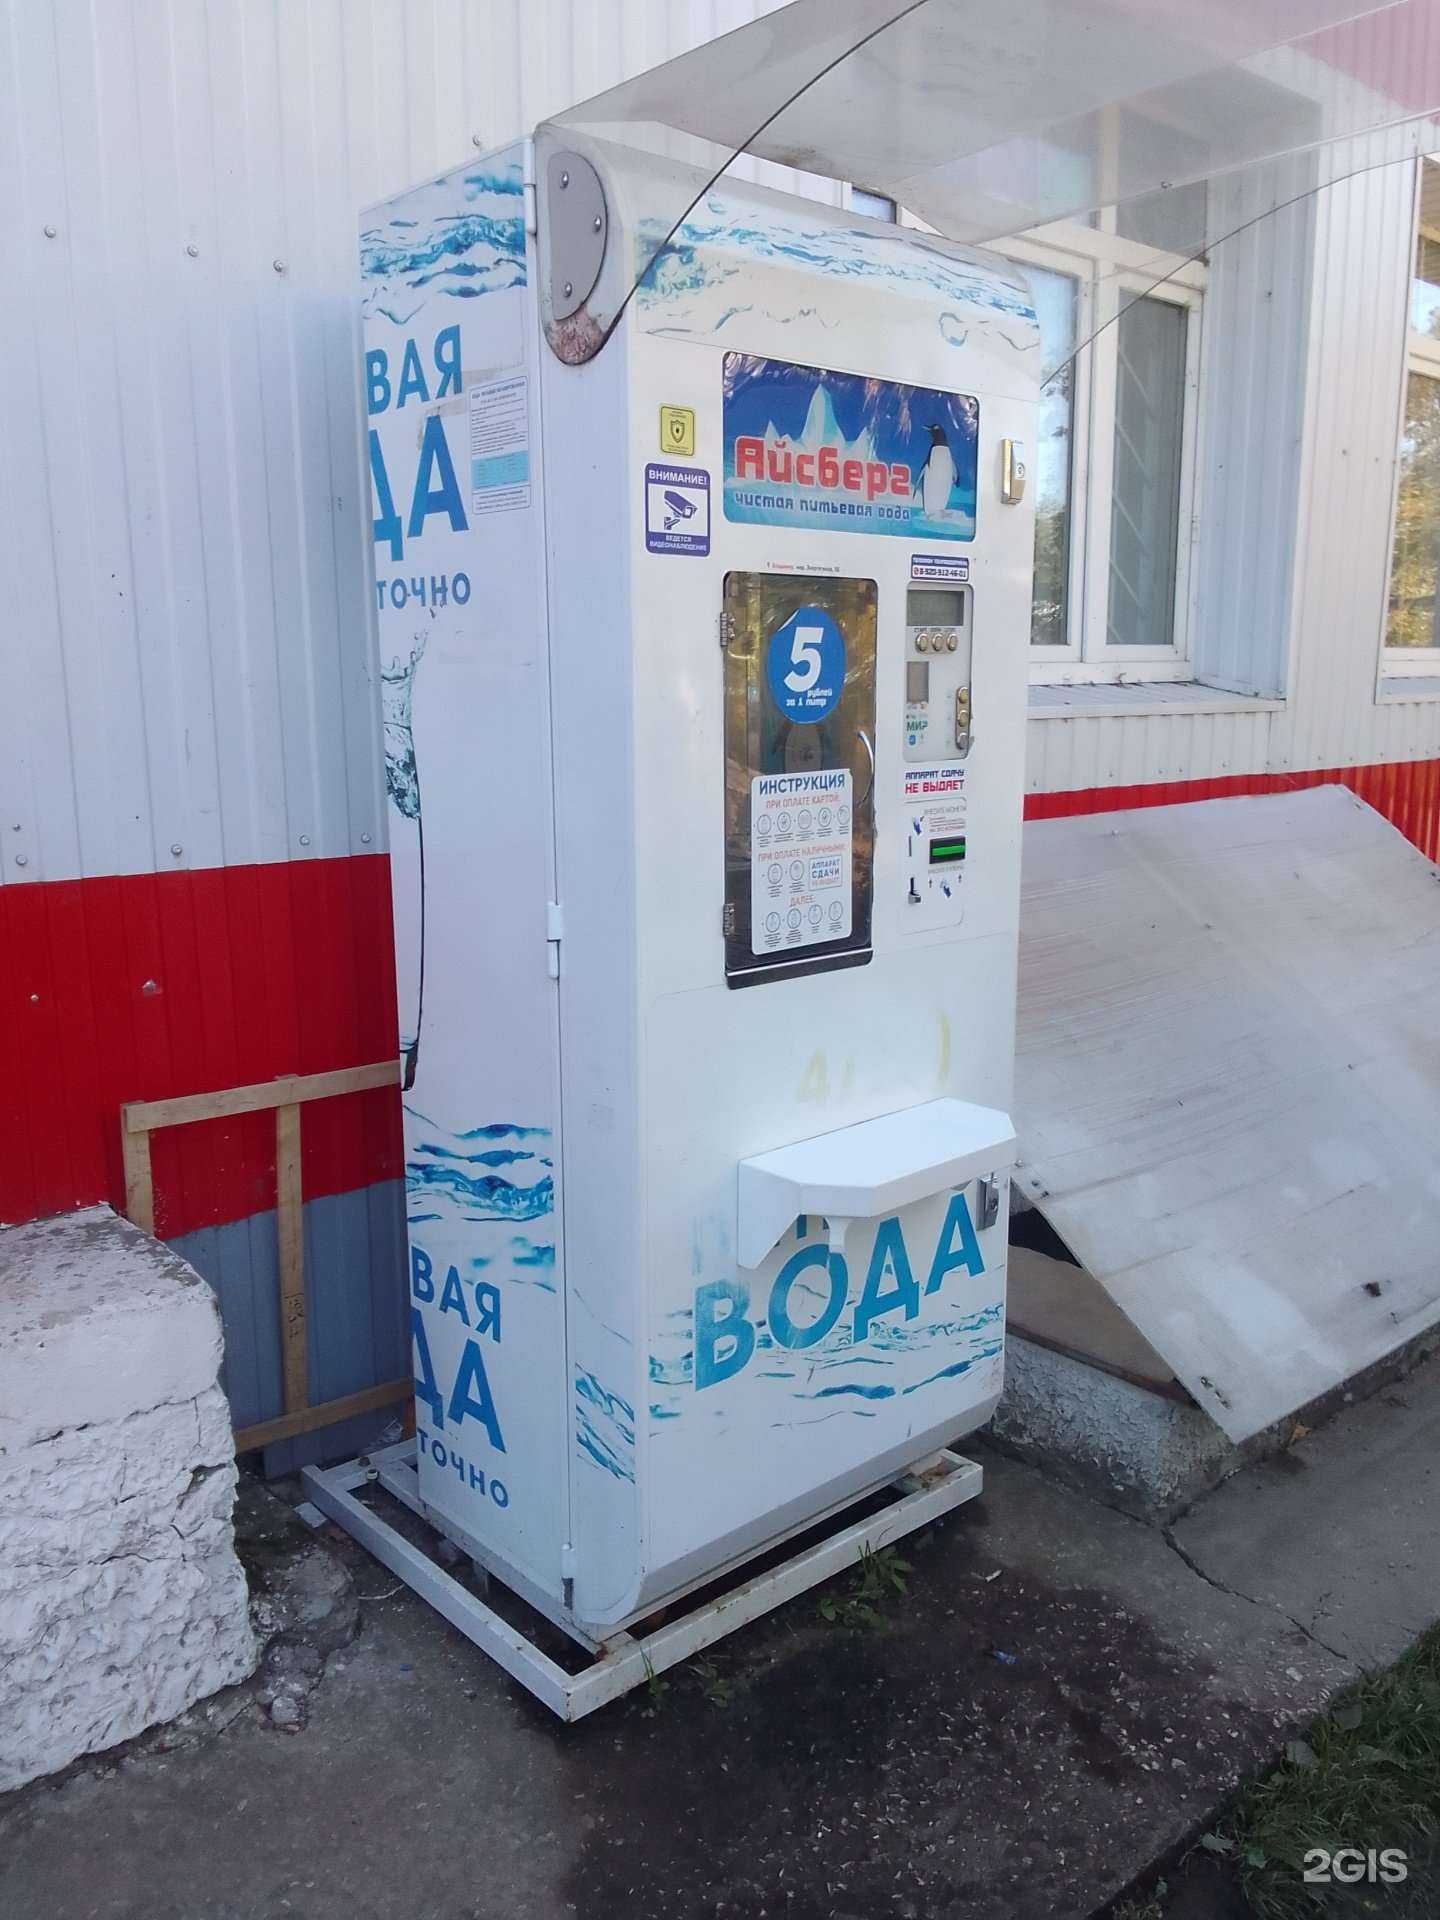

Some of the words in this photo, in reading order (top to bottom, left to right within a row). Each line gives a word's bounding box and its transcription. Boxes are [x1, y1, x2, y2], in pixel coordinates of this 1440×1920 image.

[735, 436, 911, 501] Айсберг
[648, 470, 708, 486] ВНИМАНИЕ!
[735, 492, 794, 510] чистая
[799, 499, 872, 517] питьевая
[878, 506, 910, 520] вода
[784, 627, 825, 692] 5
[807, 688, 833, 698] рублей
[786, 699, 796, 707] за
[798, 697, 803, 706] 1
[805, 698, 827, 708] литр
[905, 770, 939, 780] АППАРАТ
[941, 769, 965, 778] СДАЧУ
[759, 774, 846, 796] ИНСТРУКЦИЯ
[905, 782, 919, 794] НЕ
[922, 779, 965, 793] ВЫДАЕТ
[811, 859, 840, 870] АППАРАТ
[811, 868, 840, 879] СДАЧИ
[695, 1192, 986, 1392] ВОДА
